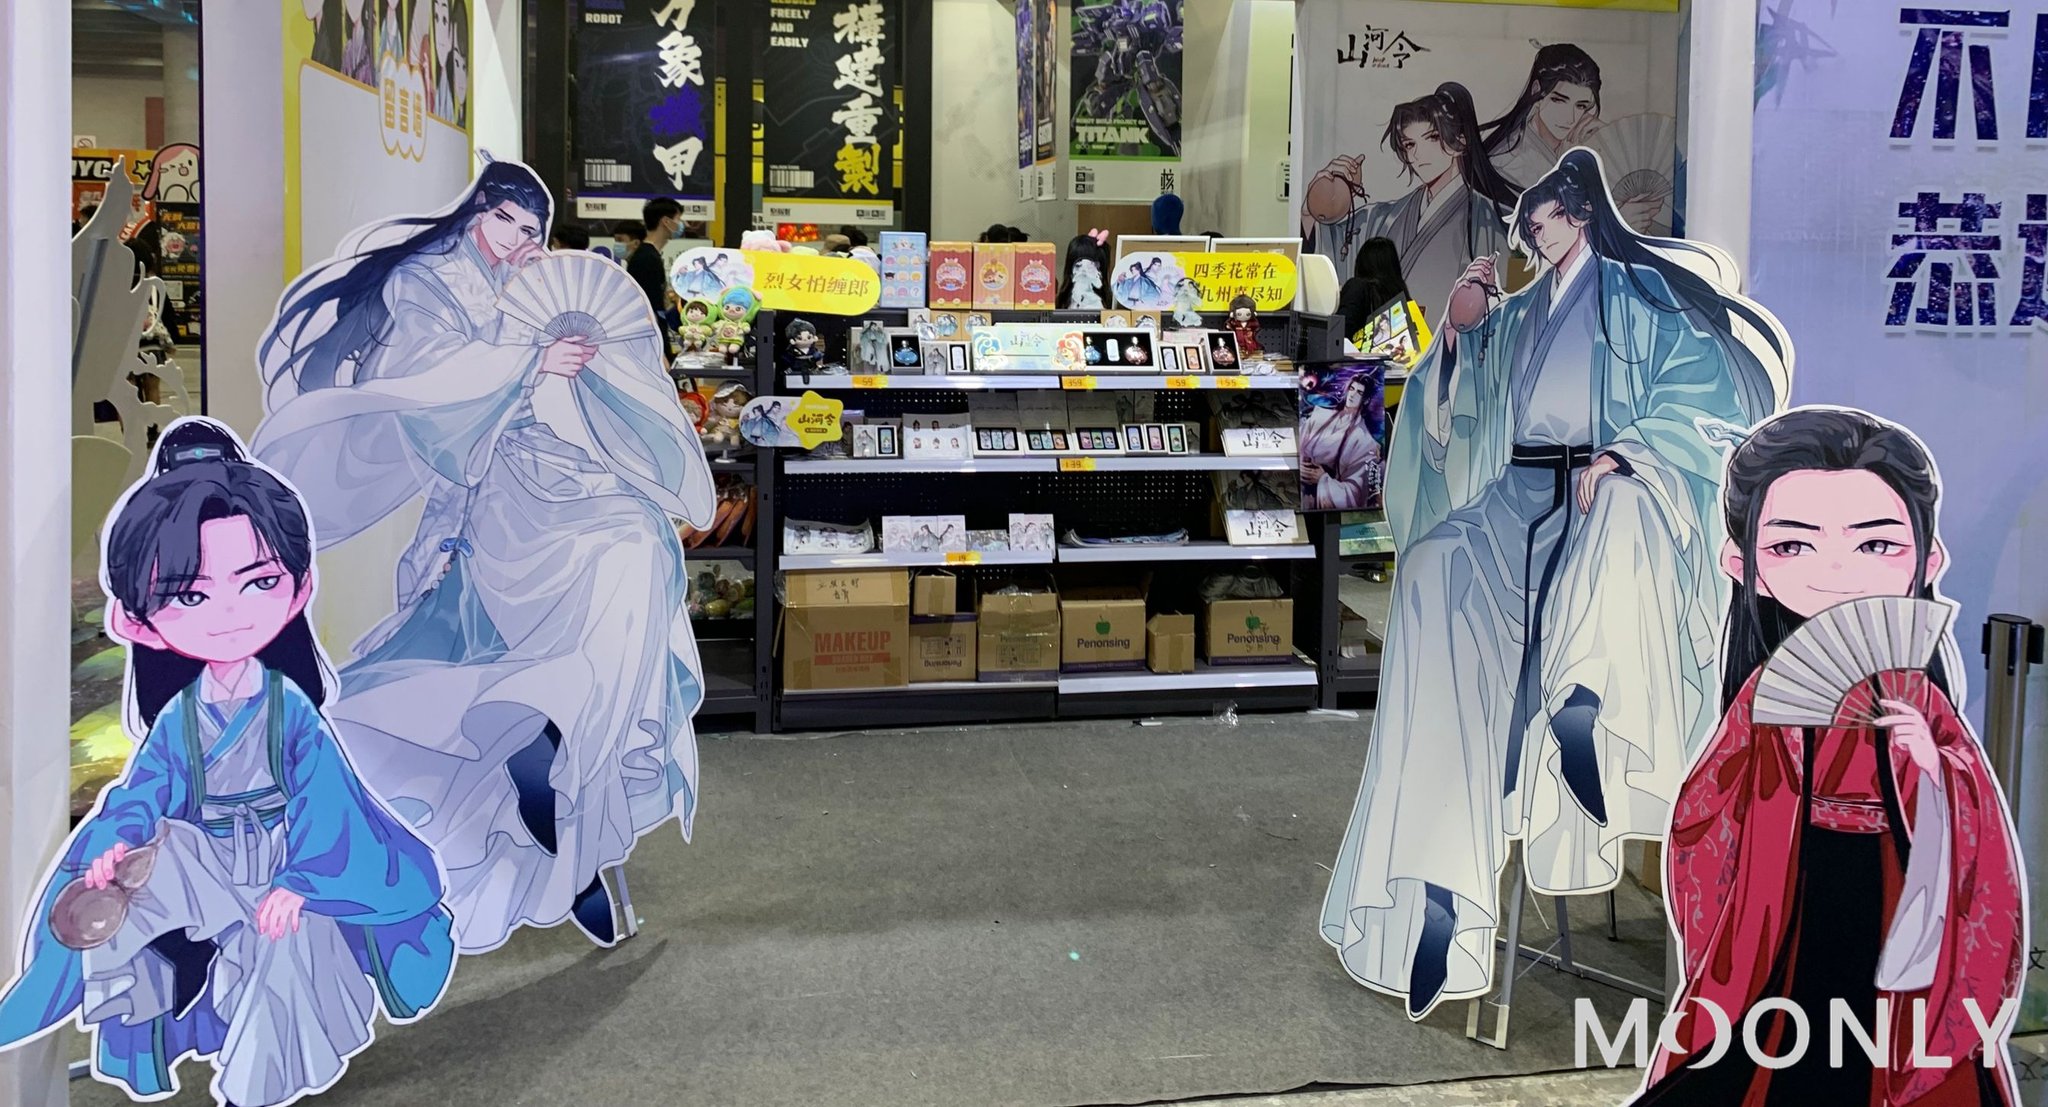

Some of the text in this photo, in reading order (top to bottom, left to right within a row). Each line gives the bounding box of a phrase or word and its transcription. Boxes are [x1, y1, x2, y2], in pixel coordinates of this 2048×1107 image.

[585, 12, 623, 24] ROBOT
[770, 8, 811, 20] FREELY
[770, 22, 794, 33] AND
[770, 36, 809, 48] EASILY
[1337, 24, 1432, 69] 山河令
[1889, 8, 2048, 141] 不
[1075, 126, 1150, 144] TITANK
[1193, 261, 1279, 280] 四季花常在
[763, 272, 870, 297] 烈女怕缠郎
[862, 377, 873, 386] 59
[798, 413, 836, 426] 山河令
[814, 631, 891, 654] MAKEUP
[1077, 637, 1131, 649] Penonsing
